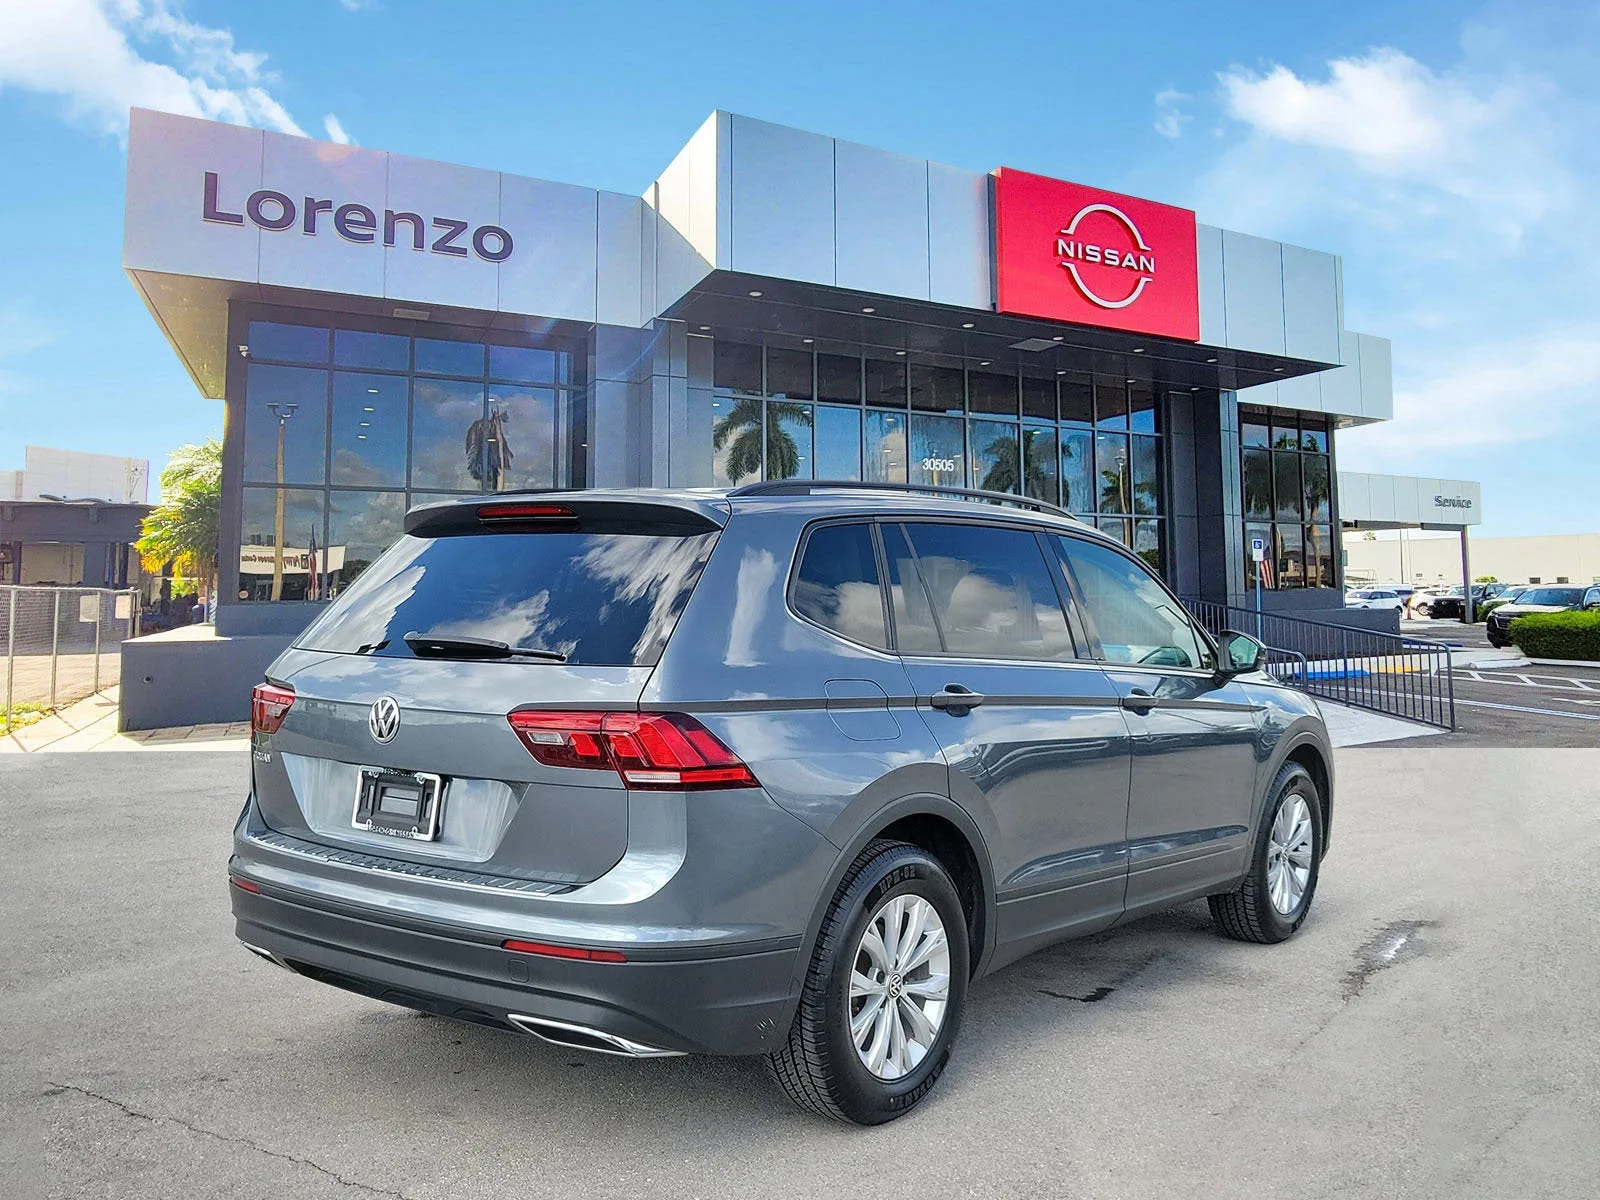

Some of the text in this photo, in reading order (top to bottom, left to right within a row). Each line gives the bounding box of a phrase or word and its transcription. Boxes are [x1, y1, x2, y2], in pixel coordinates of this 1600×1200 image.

[202, 171, 514, 262] Lorenzo
[1057, 238, 1155, 273] NISSAN
[922, 457, 955, 472] 30505
[1434, 495, 1472, 509] Service
